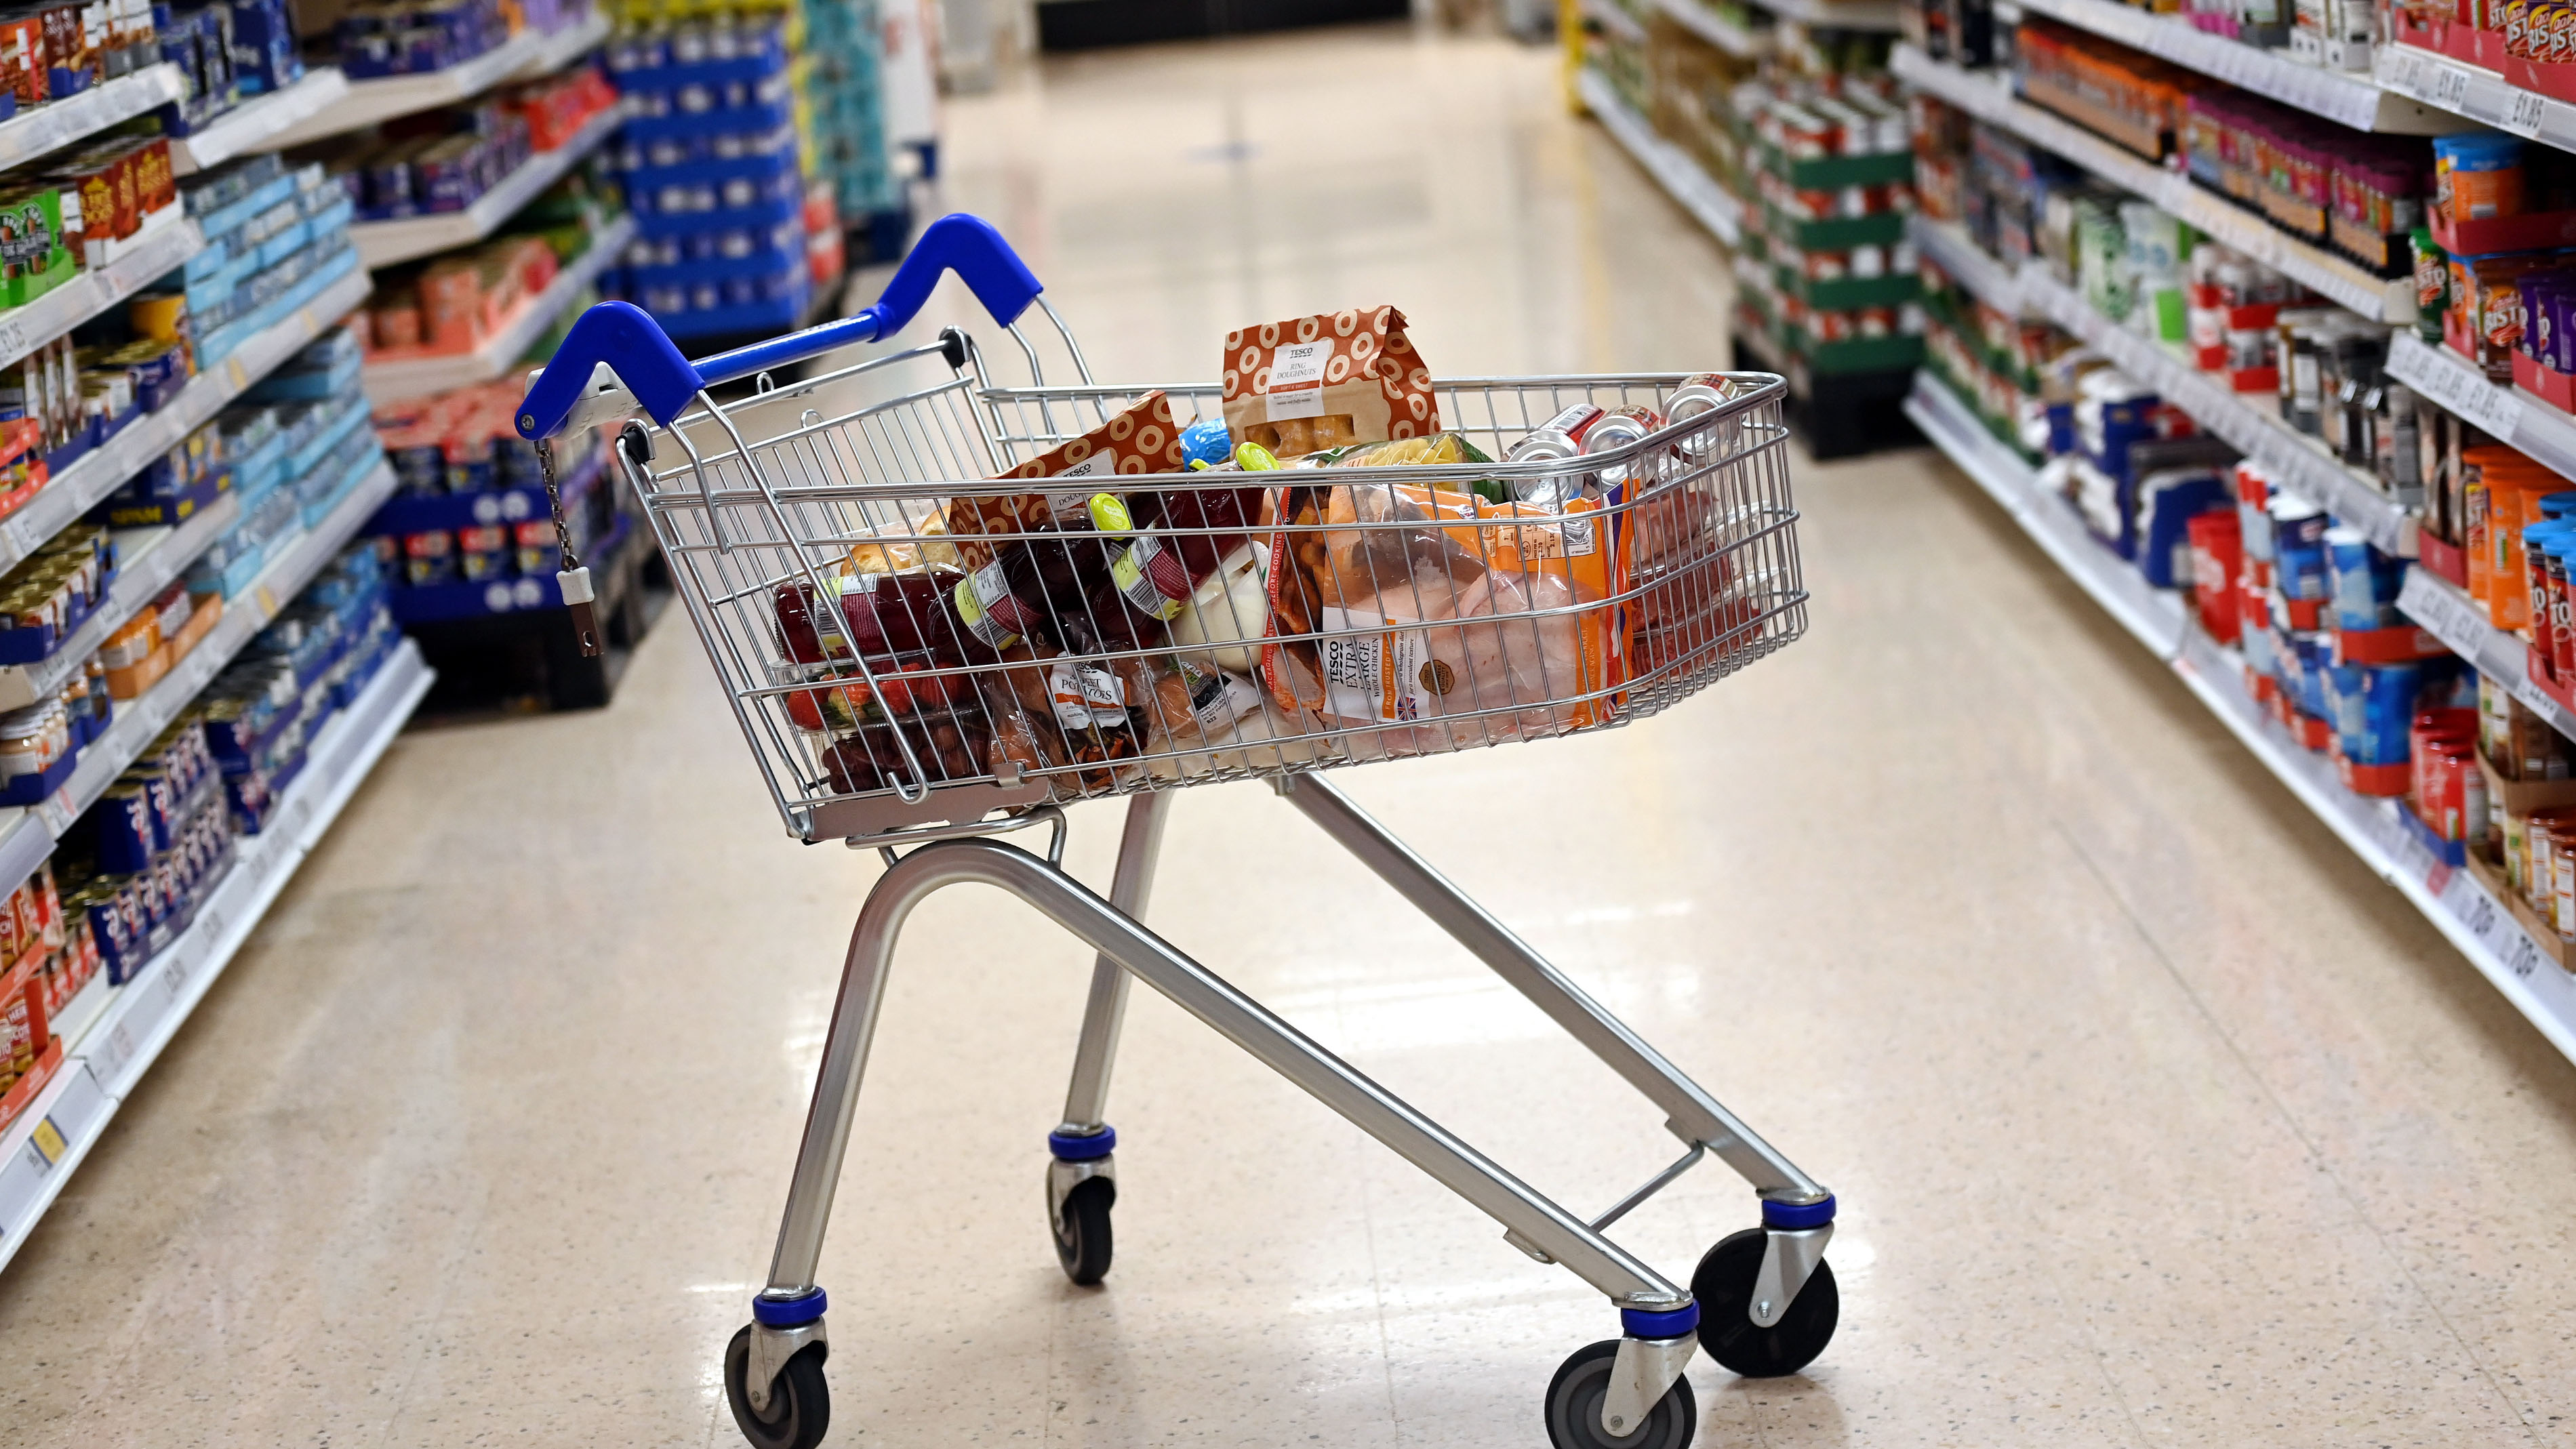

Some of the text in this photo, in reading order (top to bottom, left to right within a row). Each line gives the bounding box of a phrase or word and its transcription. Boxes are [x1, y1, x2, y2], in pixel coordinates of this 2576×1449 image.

[1290, 347, 1313, 356] TESCO
[1277, 368, 1317, 380] DOUGHNUTS
[1290, 362, 1306, 371] RING
[1273, 533, 1283, 571] COOKING
[1329, 640, 1339, 684] TESCO
[1345, 641, 1358, 689] EXTRA
[1371, 673, 1380, 697] WHOLE
